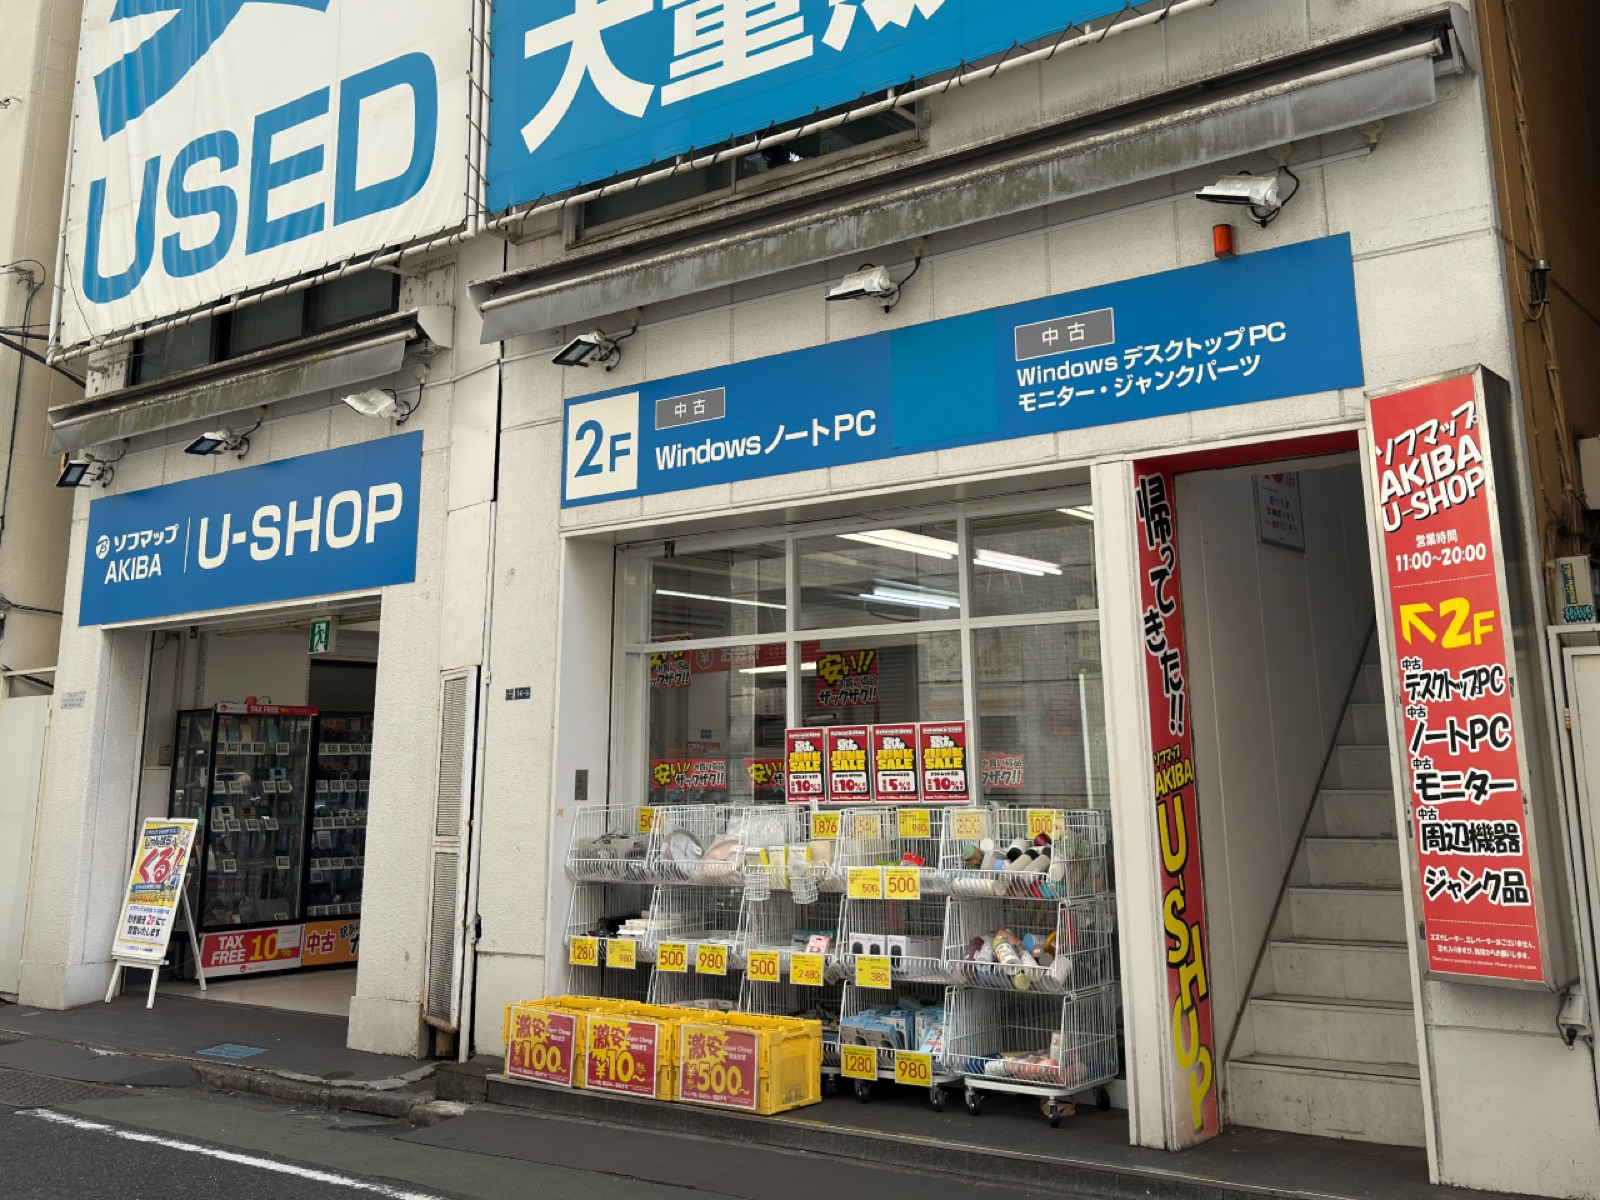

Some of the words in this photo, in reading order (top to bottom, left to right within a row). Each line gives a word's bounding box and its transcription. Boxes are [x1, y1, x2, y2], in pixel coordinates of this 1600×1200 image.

[82, 51, 438, 304] USED
[1042, 322, 1086, 347] 中古
[1018, 354, 1261, 412] モニター・ジャンクパーツ
[674, 398, 706, 418] 中古
[1375, 400, 1479, 466] ソフマップ
[574, 419, 632, 478] 2F
[1381, 434, 1482, 505] AKIBA
[1382, 466, 1486, 532] U-SHOP
[198, 482, 403, 570] U-SHOP
[114, 524, 179, 552] ソフマップ
[1416, 529, 1458, 548] 営業時間
[104, 554, 162, 585] AKIBA
[1439, 597, 1495, 649] 2F
[1402, 658, 1421, 671] 中古
[1404, 665, 1505, 701] デスクトップPC
[1407, 705, 1427, 719] 中古
[1410, 715, 1510, 754] ノートPC
[789, 760, 821, 771] SALE
[832, 759, 866, 771] SALE
[877, 758, 913, 770] SALE
[924, 758, 963, 769] SALE
[1412, 757, 1432, 770] 中古
[1155, 757, 1194, 799] AKIBA
[1415, 770, 1515, 803] モニター
[1418, 807, 1437, 821] 中古
[1420, 822, 1521, 854] 周辺機器
[888, 877, 916, 893] 500
[1424, 867, 1530, 904] ジャンク品
[219, 934, 245, 950] TAX
[306, 930, 336, 955] 中古
[211, 949, 246, 965] FREE
[619, 954, 632, 963] 980
[660, 951, 684, 966] 500
[700, 953, 723, 969] 980
[750, 960, 776, 976] 500
[871, 972, 887, 981] 380
[845, 1055, 872, 1073] 1,280
[898, 1061, 927, 1079] 980
